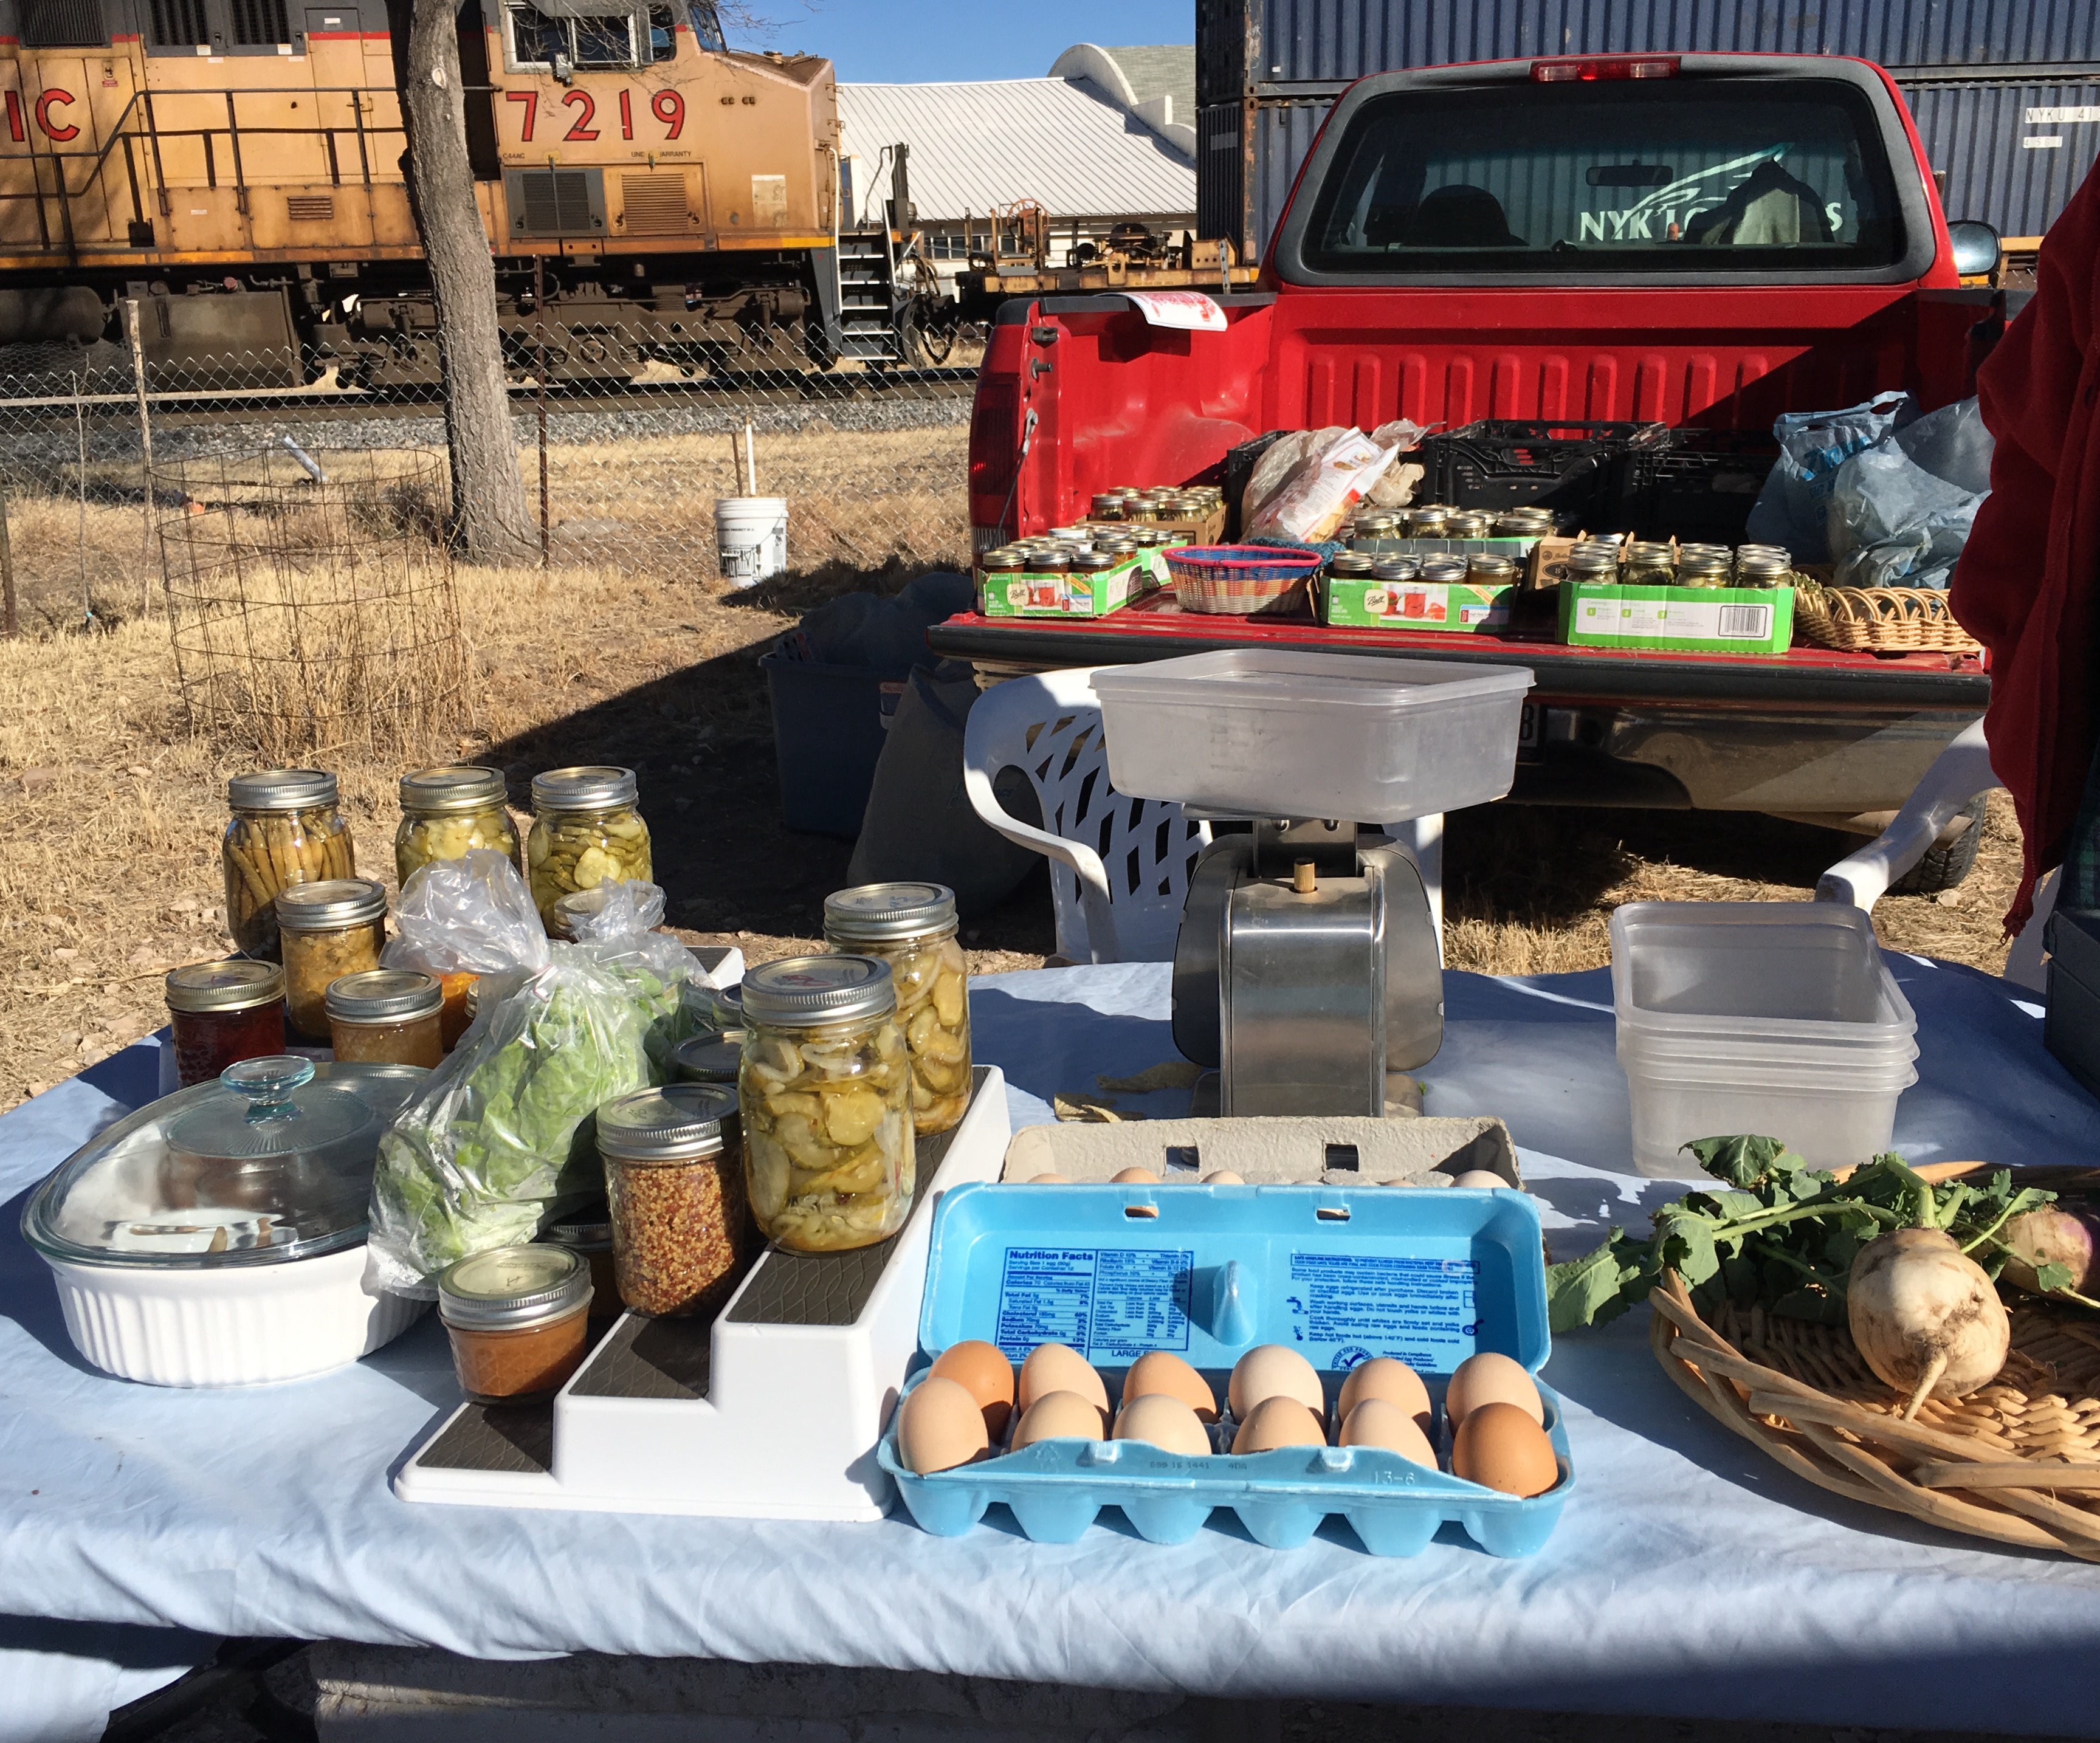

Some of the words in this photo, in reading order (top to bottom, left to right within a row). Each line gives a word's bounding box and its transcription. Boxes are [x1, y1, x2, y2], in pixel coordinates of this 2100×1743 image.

[506, 89, 685, 142] 7219
[2026, 108, 2065, 122] NYKU
[1580, 208, 1652, 241] NYK
[1010, 588, 1025, 600] Ball
[1367, 595, 1385, 607] Ball
[1010, 1251, 1059, 1259] Nutrition
[1062, 1252, 1093, 1260] Facts
